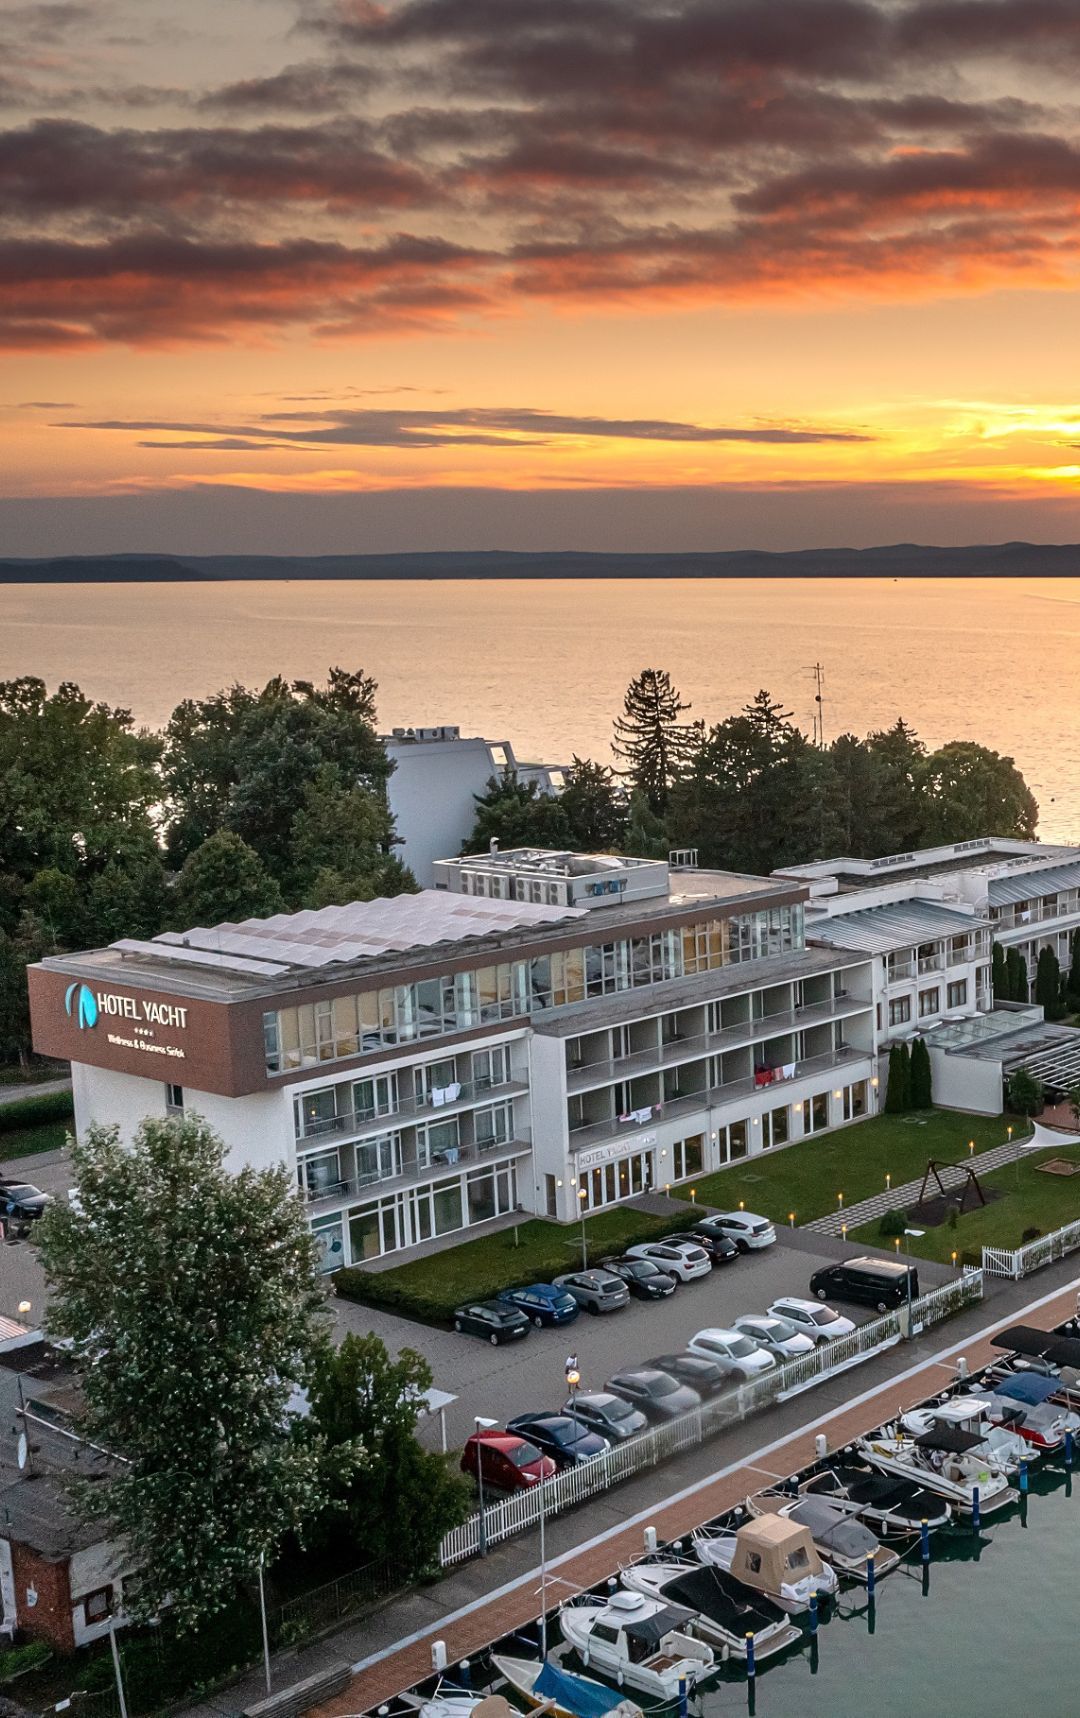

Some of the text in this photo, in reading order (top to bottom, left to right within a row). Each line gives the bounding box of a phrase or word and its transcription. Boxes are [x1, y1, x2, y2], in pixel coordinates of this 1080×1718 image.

[97, 992, 188, 1028] HOTEL YACHT
[580, 1150, 605, 1165] HOTEL
